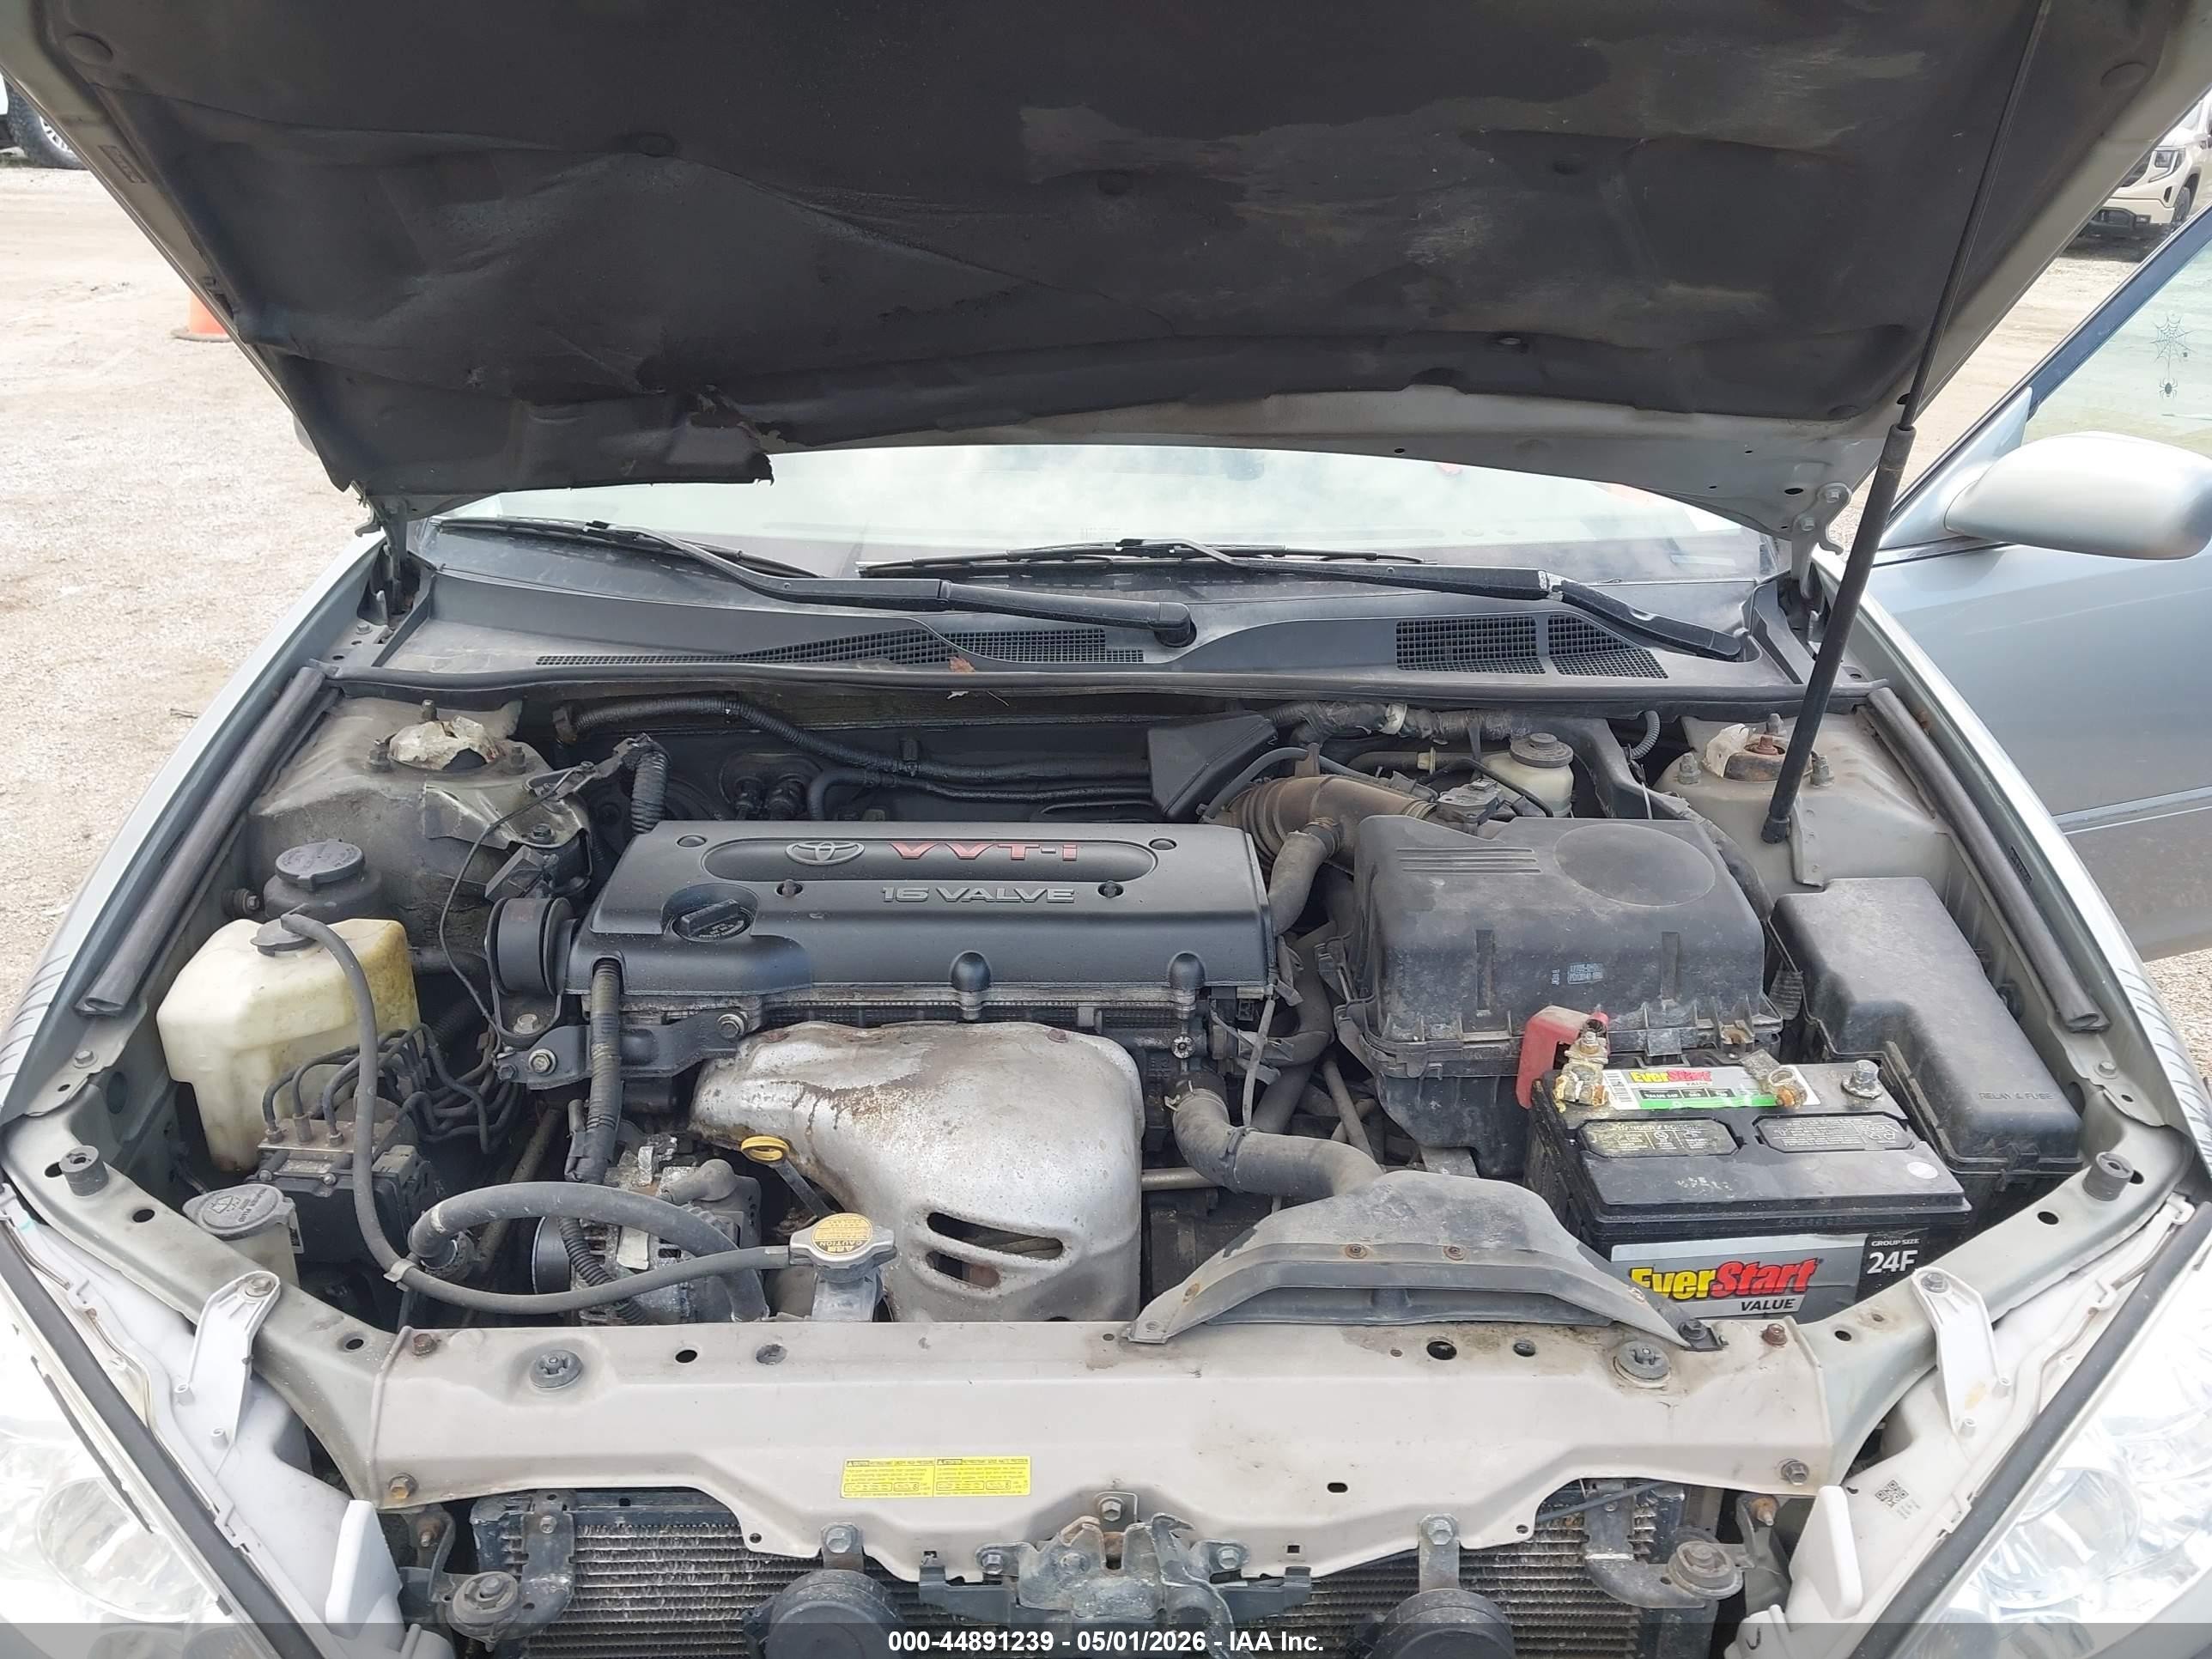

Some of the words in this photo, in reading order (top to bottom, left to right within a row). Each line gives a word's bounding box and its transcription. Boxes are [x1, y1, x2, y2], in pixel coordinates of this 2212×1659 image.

[881, 886, 929, 902] 16
[935, 886, 1075, 903] VALVE
[1867, 1249, 1918, 1274] 24F
[1630, 1258, 1817, 1300] EverStart
[1740, 1297, 1797, 1311] VALUE
